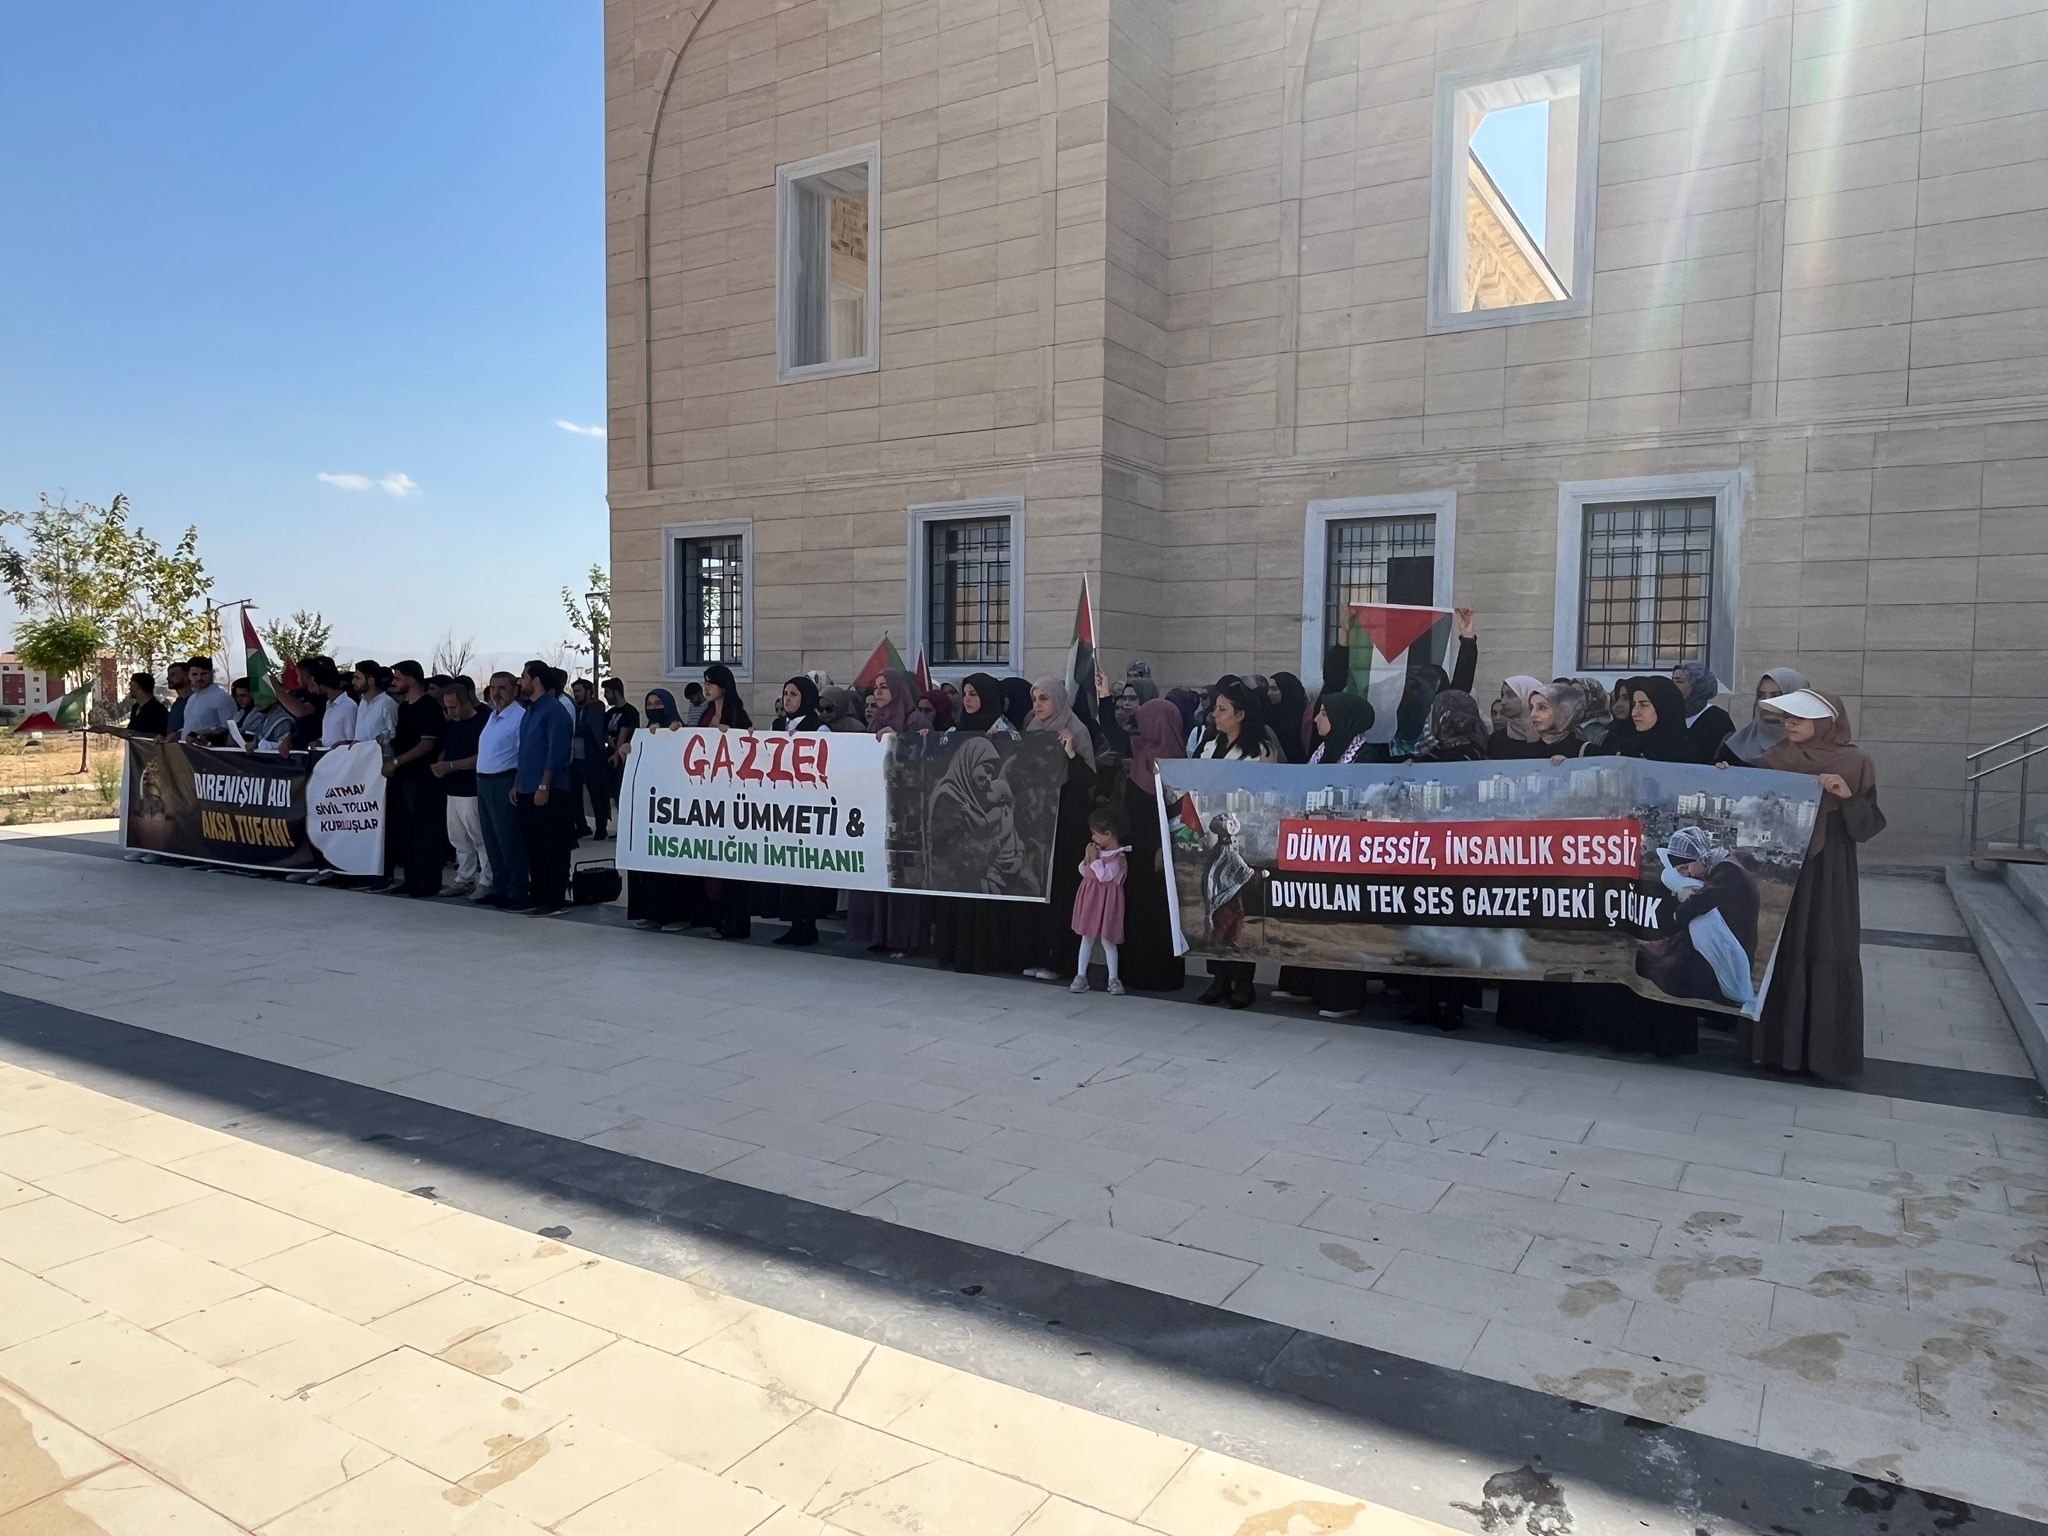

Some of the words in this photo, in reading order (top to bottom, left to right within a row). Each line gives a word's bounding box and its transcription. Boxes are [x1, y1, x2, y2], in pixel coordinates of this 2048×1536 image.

[683, 734, 829, 789] GAZZE!
[267, 778, 292, 808] ADI
[315, 802, 343, 815] SİVİL
[342, 800, 379, 813] TOLUM
[648, 786, 725, 828] İSLAM
[733, 793, 838, 836] ÜMMETİ
[846, 808, 865, 837] &
[202, 810, 237, 842] AKSA
[647, 827, 758, 864] İNSANLIĞIN
[763, 836, 865, 873] İMTİHANI!
[1286, 828, 1351, 862] DÜNYA
[1358, 831, 1437, 870] SESSİZ,
[1445, 830, 1554, 865] İNSANLIK
[1562, 829, 1637, 867] SESSİZ
[1271, 880, 1361, 911] DUYULAN
[1367, 885, 1407, 914] TEK
[1413, 886, 1454, 915] SES
[1462, 883, 1595, 919] GAZZE'DEKİ
[1604, 883, 1663, 929] ÇIĞLIK
